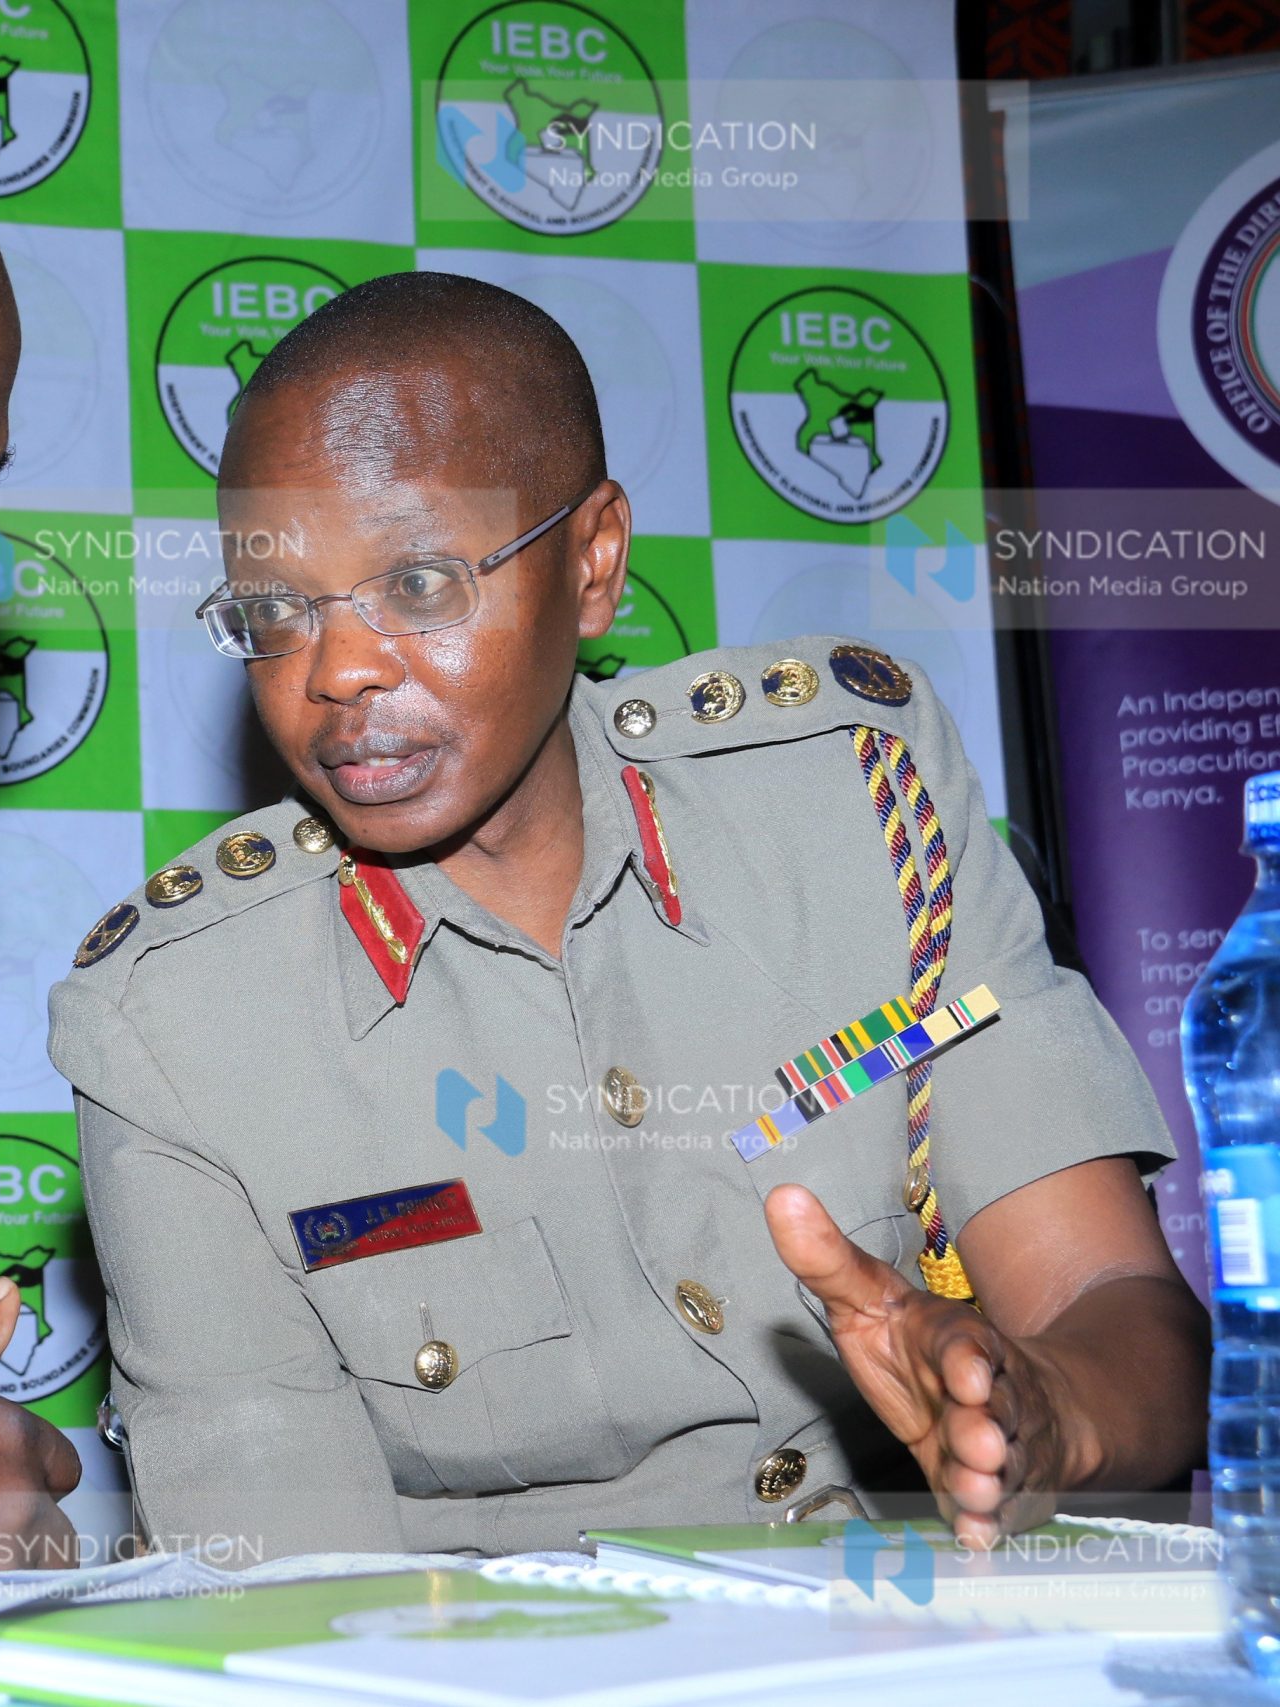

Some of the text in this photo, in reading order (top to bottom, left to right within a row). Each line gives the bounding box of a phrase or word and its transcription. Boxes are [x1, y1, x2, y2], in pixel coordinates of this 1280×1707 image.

[491, 20, 607, 64] IEBC
[1206, 192, 1280, 434] OFFICE OF THE DIR
[780, 311, 892, 353] IEBC
[1117, 687, 1280, 718] An Indepen
[1120, 717, 1253, 752] providing
[1124, 784, 1224, 811] Kenya.
[1137, 927, 1170, 951] To
